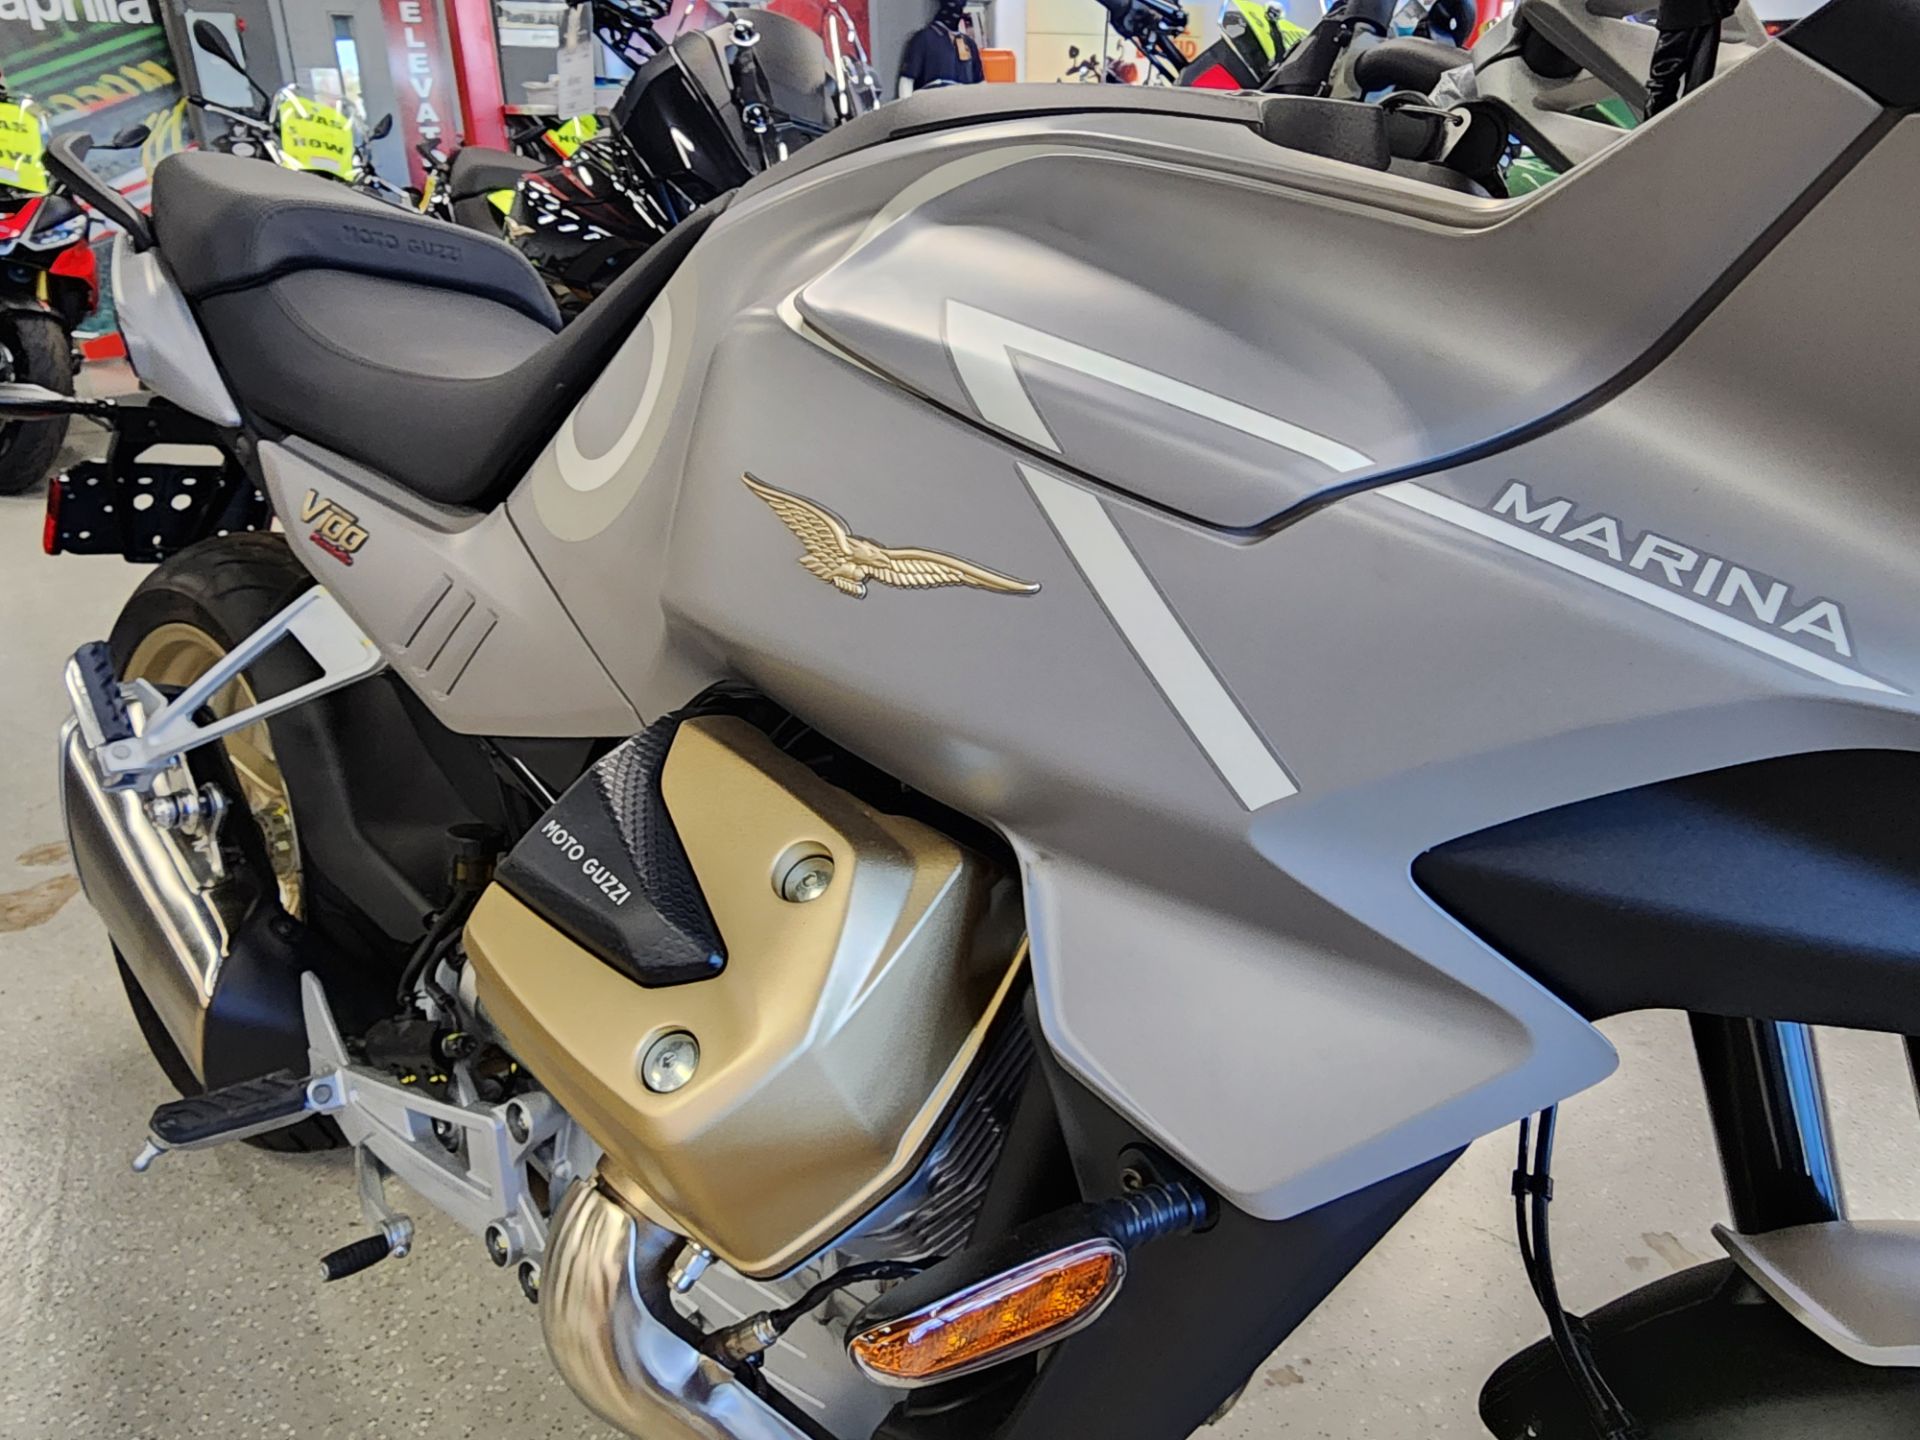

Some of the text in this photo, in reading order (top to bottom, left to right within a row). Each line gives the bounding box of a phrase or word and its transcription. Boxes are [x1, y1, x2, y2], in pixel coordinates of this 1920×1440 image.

[341, 225, 462, 262] MOTO GUZZI
[301, 488, 369, 553] V100
[1492, 481, 1853, 658] MARINA
[541, 819, 632, 906] MOTO GUZZI
